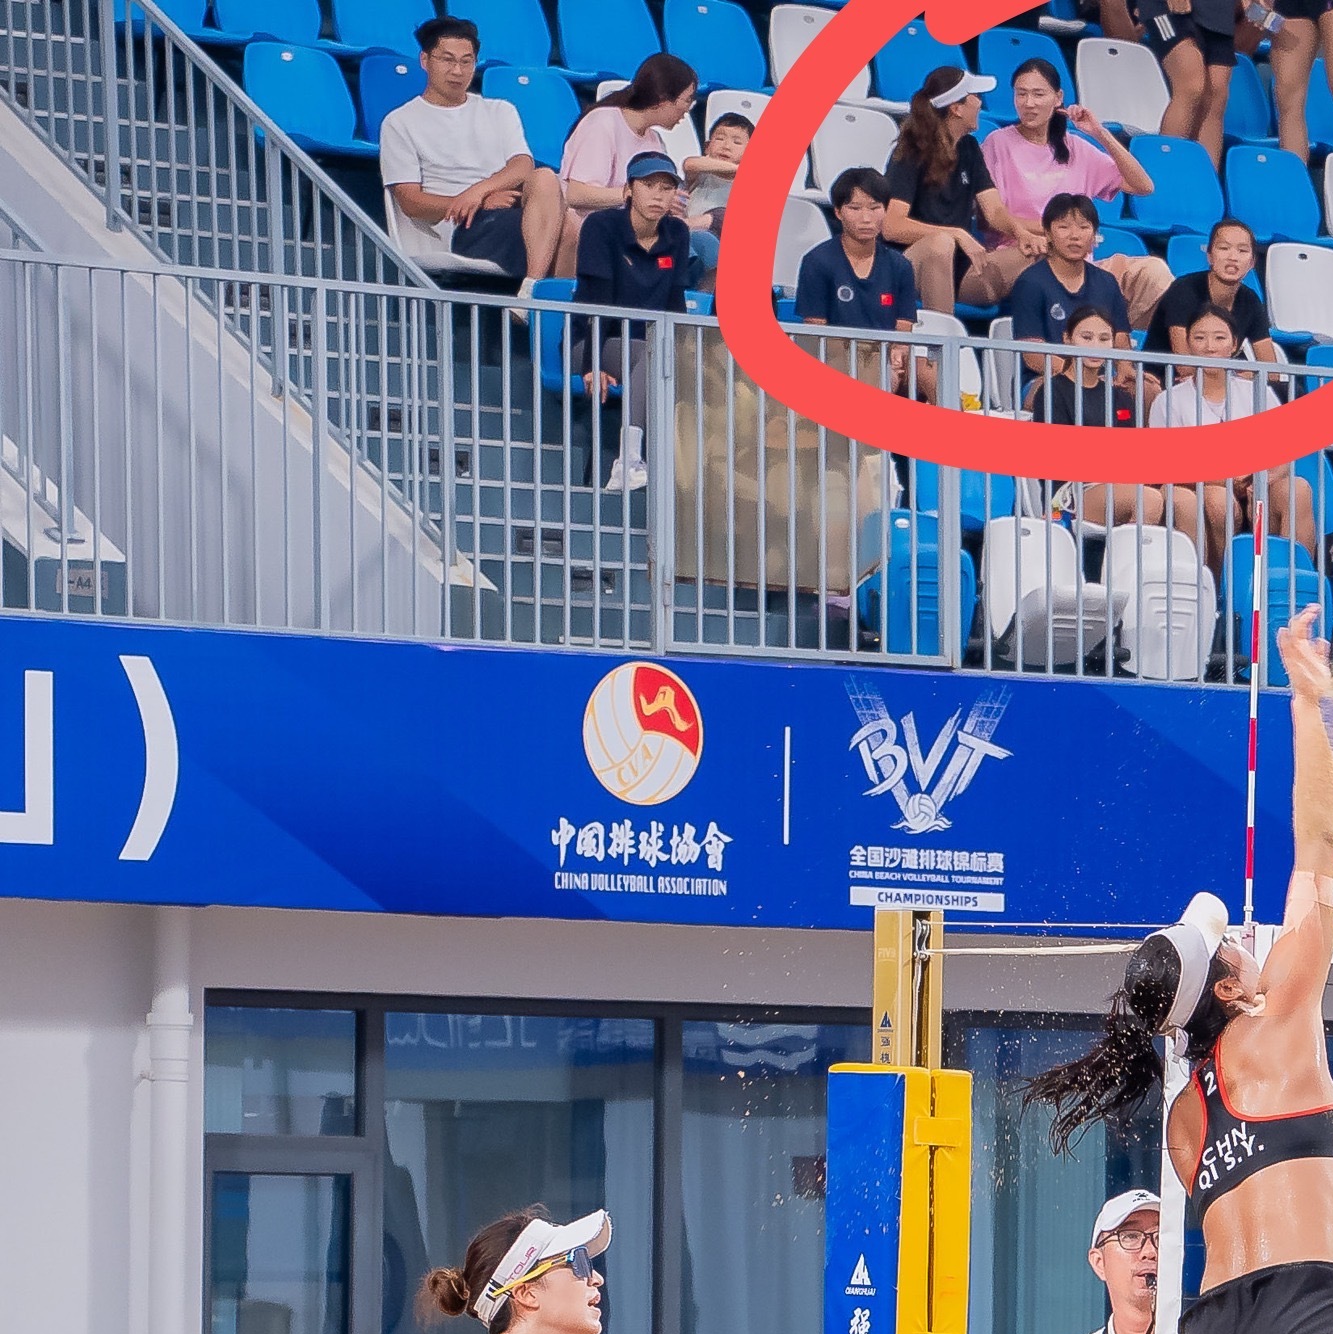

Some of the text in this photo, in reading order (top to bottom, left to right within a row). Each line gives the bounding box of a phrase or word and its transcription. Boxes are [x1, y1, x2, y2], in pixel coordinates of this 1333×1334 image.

[617, 750, 653, 787] CVA
[850, 845, 1004, 873] 全国沙滩排球锦标赛
[555, 871, 727, 896] CHINA VOLLEYBALL ASSOCIATION
[849, 870, 1004, 886] CHINA BEACH VOLLEYBALL TOURNAMENT
[877, 891, 978, 908] CHAMPIONSHIPS
[1204, 1071, 1217, 1097] 2
[1202, 1122, 1247, 1166] CHN
[1198, 1165, 1219, 1190] QI
